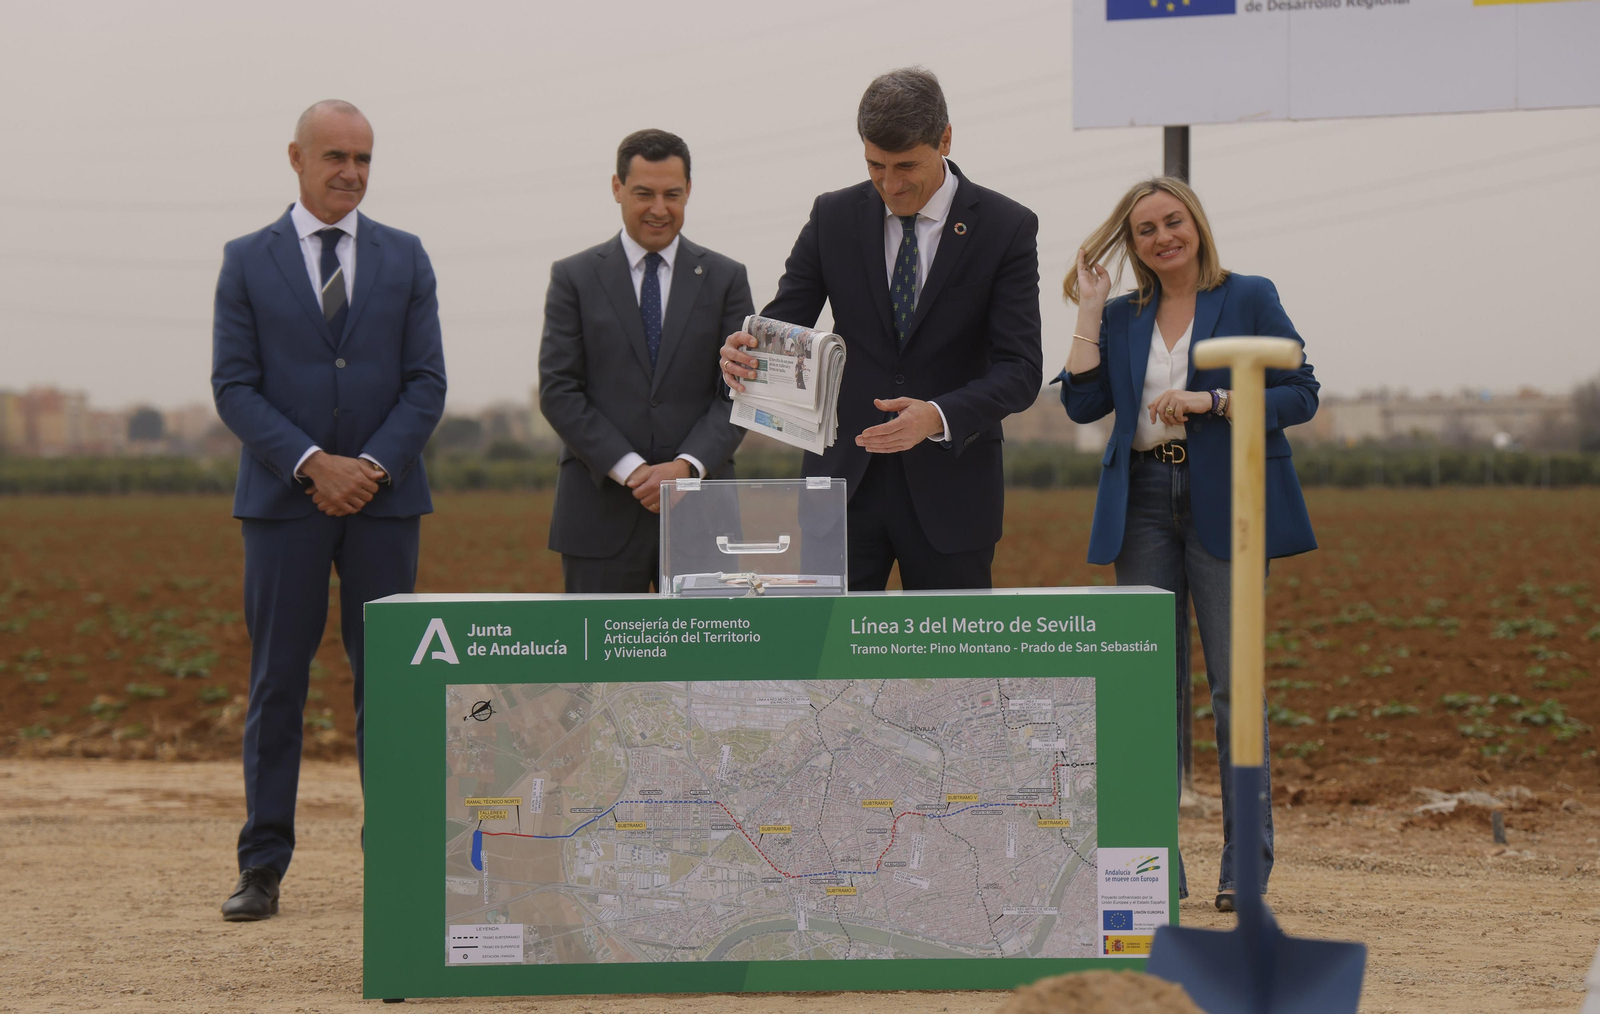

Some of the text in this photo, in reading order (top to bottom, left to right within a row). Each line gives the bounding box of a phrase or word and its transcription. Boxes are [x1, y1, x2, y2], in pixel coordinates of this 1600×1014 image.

[1244, 0, 1263, 12] de
[1266, 0, 1342, 12] Desarrollo
[467, 624, 512, 638] Junta
[604, 617, 750, 632] Consejería de Formento
[850, 616, 1096, 634] Línea 3 del Metro de Sevilla
[604, 630, 761, 644] Articulación del Territorio
[467, 640, 568, 656] de Andalucía
[604, 646, 667, 660] y Vivienda
[850, 644, 888, 654] Tramo
[891, 643, 927, 654] Norte:
[930, 642, 956, 654] Pino
[960, 642, 1011, 654] Montano
[1020, 642, 1056, 654] Prado
[1058, 642, 1073, 653] de
[1075, 642, 1098, 652] San
[1100, 640, 1158, 652] Sebastián
